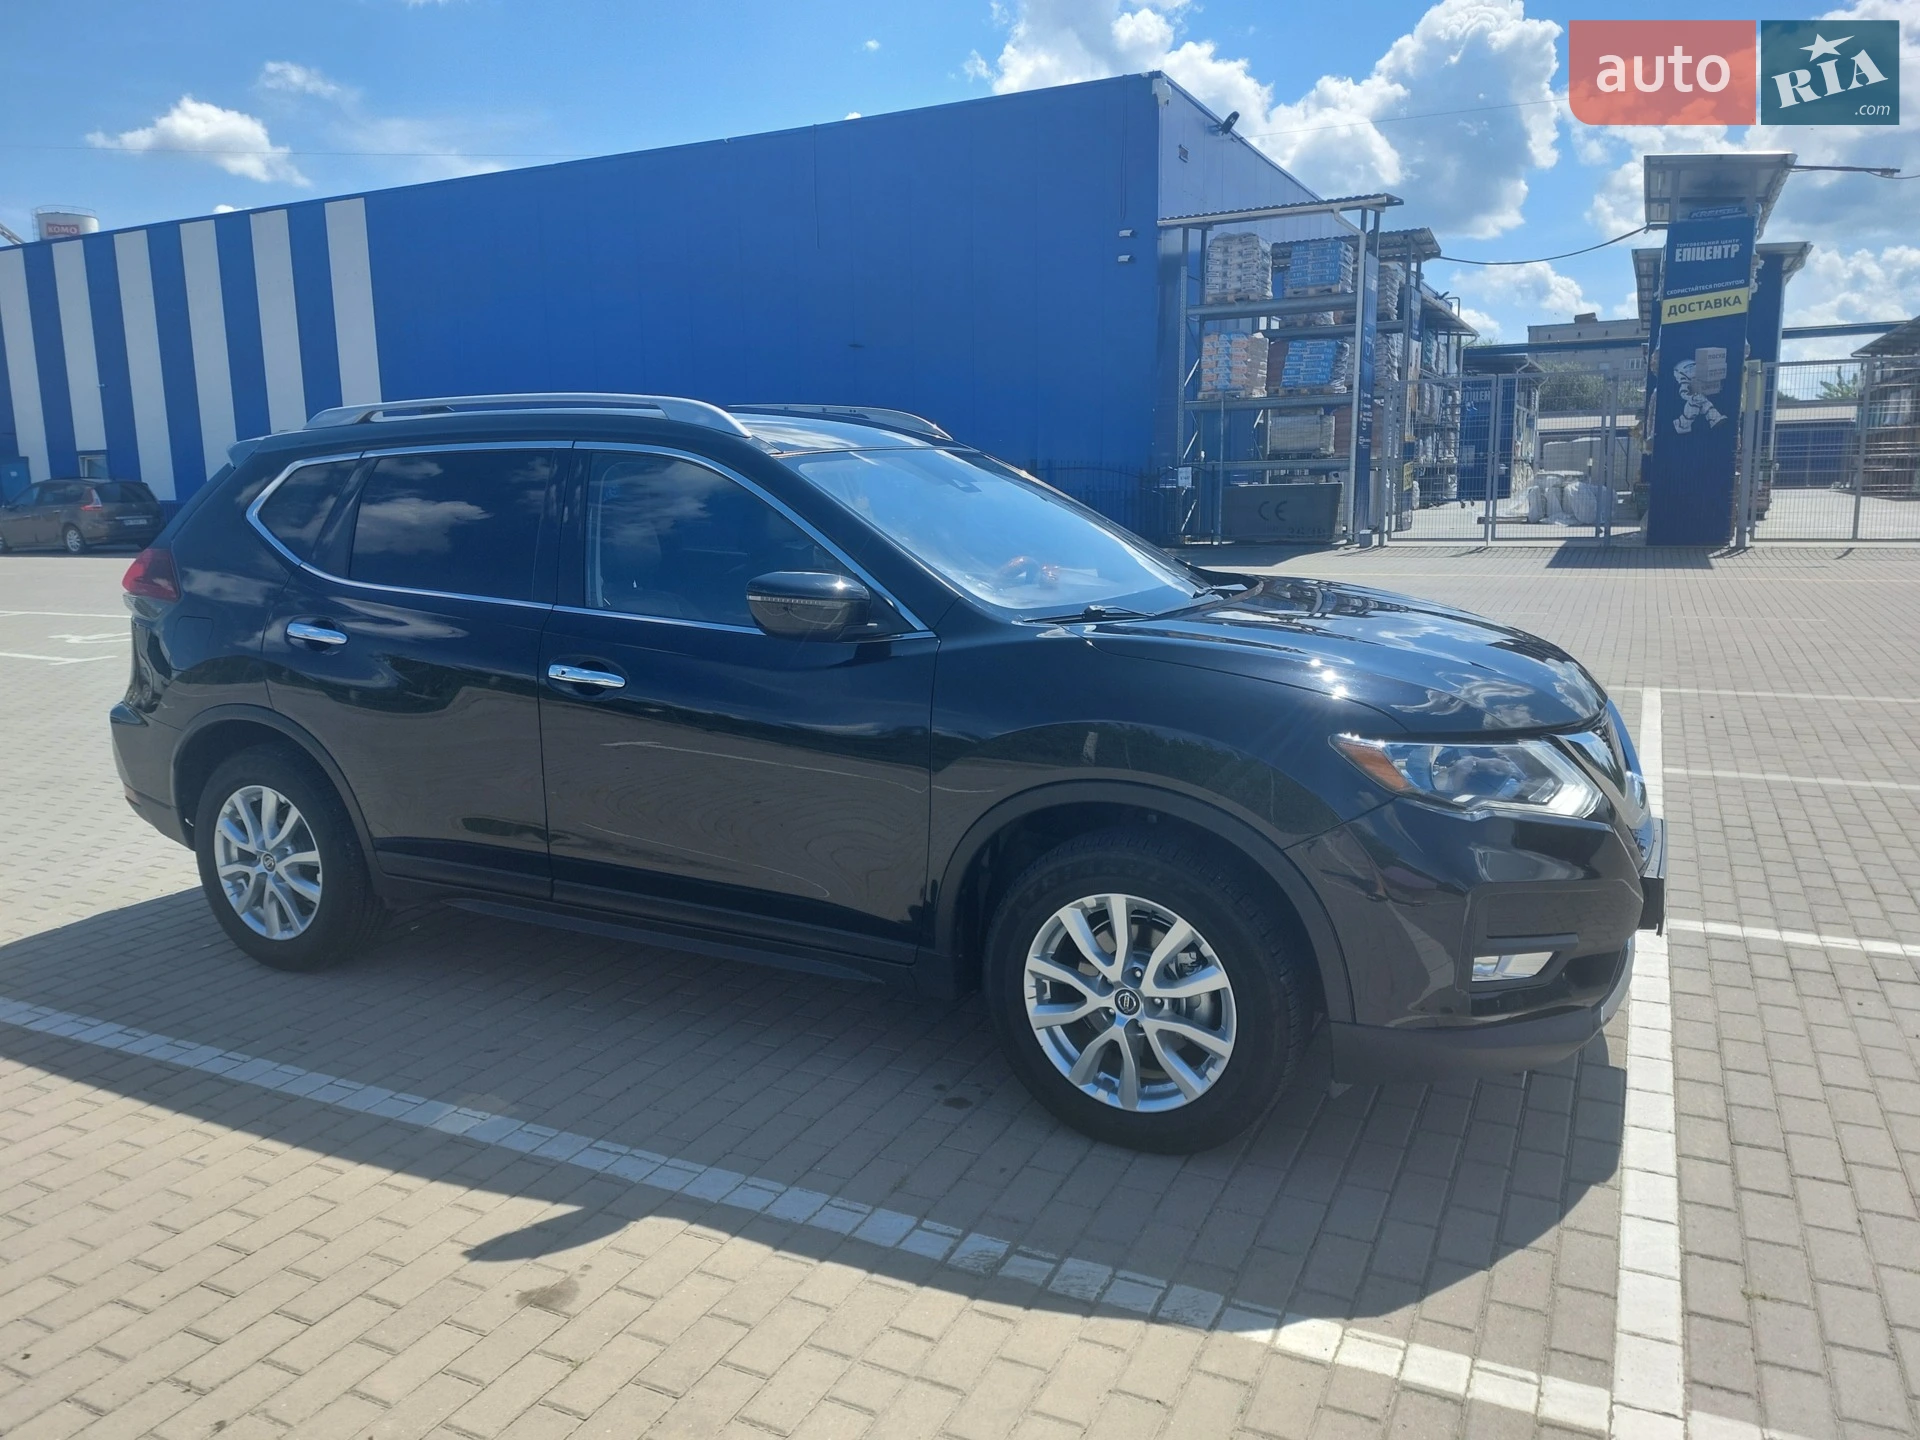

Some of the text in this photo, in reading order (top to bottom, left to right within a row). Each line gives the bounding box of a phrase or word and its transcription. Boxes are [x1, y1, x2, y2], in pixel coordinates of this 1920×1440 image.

[1675, 244, 1740, 262] ЕПІЦЕНТР
[1666, 279, 1745, 296] СКОРИСТАЙТЕСЯ ПОСЛУГОЮ
[1667, 295, 1742, 317] ДОСТАВКА
